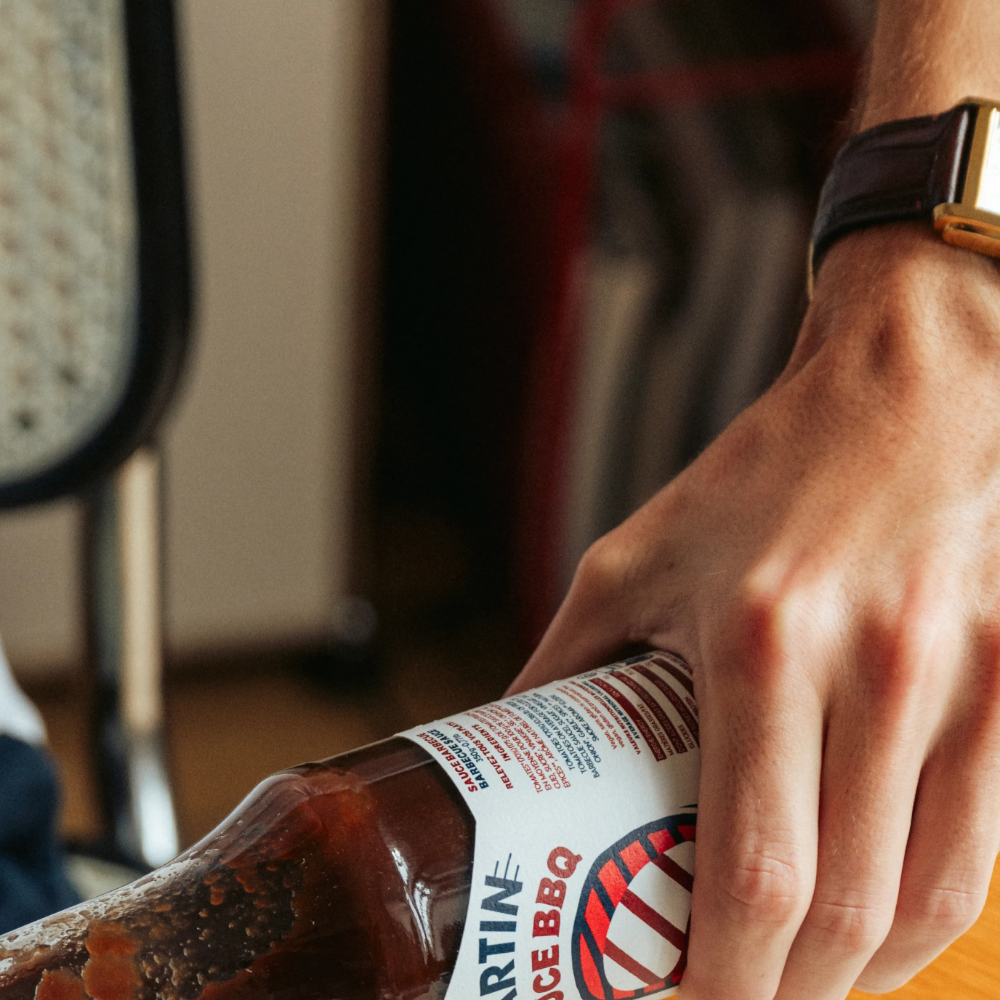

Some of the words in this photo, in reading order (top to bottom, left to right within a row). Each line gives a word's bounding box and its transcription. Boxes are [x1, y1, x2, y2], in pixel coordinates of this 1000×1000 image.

[536, 710, 559, 731] AVERAGE
[582, 705, 598, 719] gluten
[594, 718, 605, 730] sans
[598, 713, 614, 729] gluten
[426, 727, 453, 745] SAUCE
[461, 729, 476, 741] VOS
[553, 729, 566, 740] ON
[581, 721, 599, 741] SMOKE
[621, 715, 641, 739] AVERAGE
[415, 730, 456, 762] BARBECUE
[471, 722, 511, 762] INGREDIENTS
[472, 738, 490, 756] TOUS
[510, 734, 527, 751] POUR
[549, 736, 575, 770] TOMATOES
[622, 729, 642, 755] VALEURS
[448, 742, 489, 789] BARBECUE
[522, 749, 547, 780] MOYENNE
[562, 739, 587, 773] TOMATOES
[575, 744, 600, 778] BARBECUE
[449, 759, 478, 793] SAUCE
[485, 754, 514, 789] RELEVEZ
[542, 779, 552, 791] EN
[532, 846, 583, 938] BBQ
